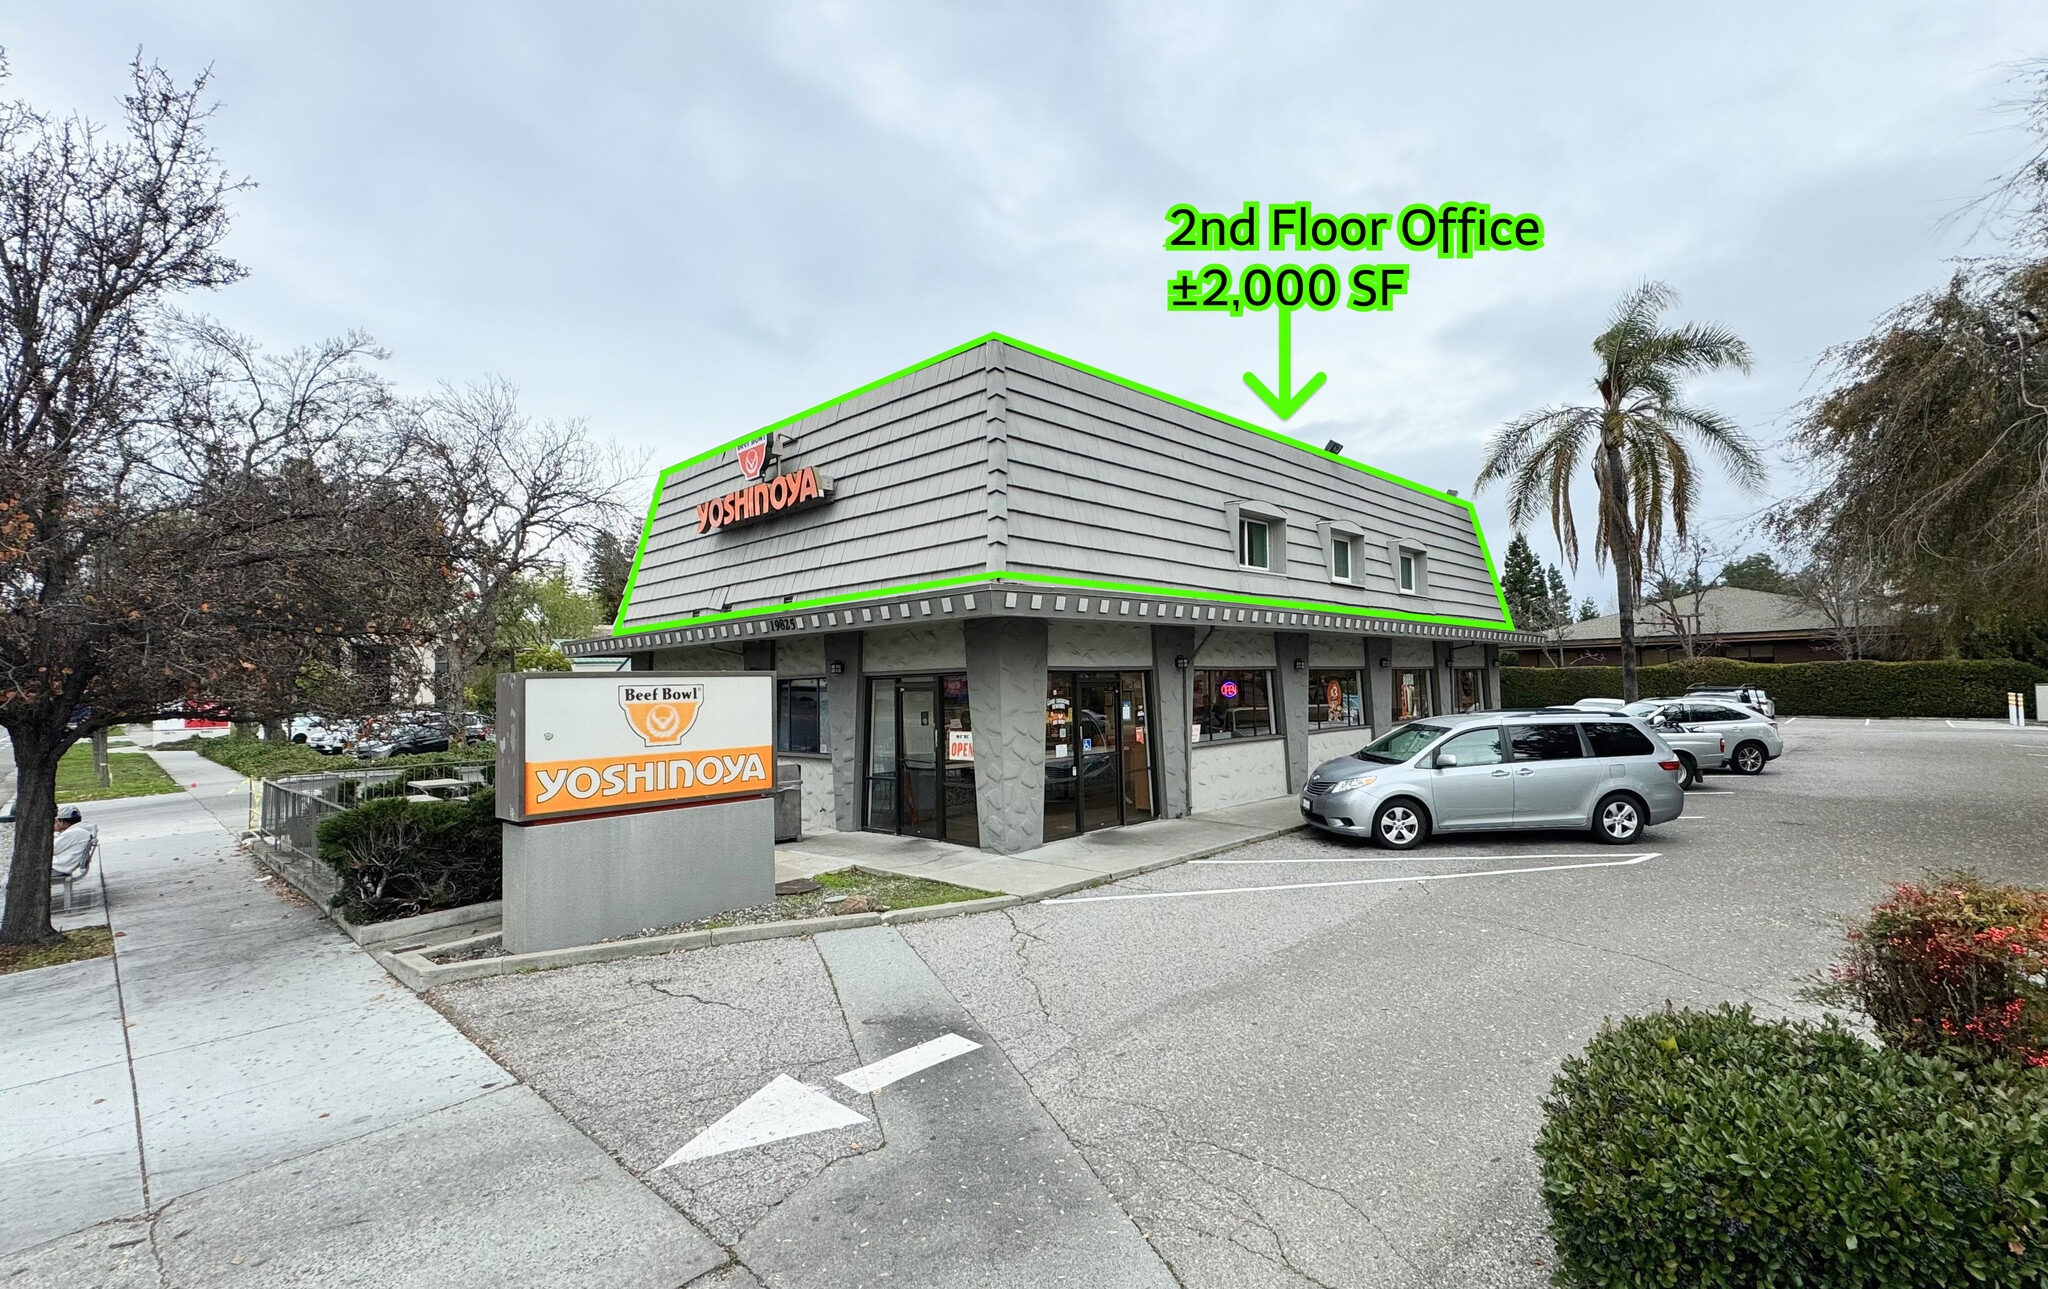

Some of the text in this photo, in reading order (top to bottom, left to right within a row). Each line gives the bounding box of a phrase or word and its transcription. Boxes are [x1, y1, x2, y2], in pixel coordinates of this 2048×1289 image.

[696, 466, 819, 534] YOSHINOYA
[770, 618, 796, 631] 19825
[625, 687, 698, 701] Beef Bowl
[951, 742, 974, 757] OPEN
[536, 753, 767, 804] YOSHINOYA
